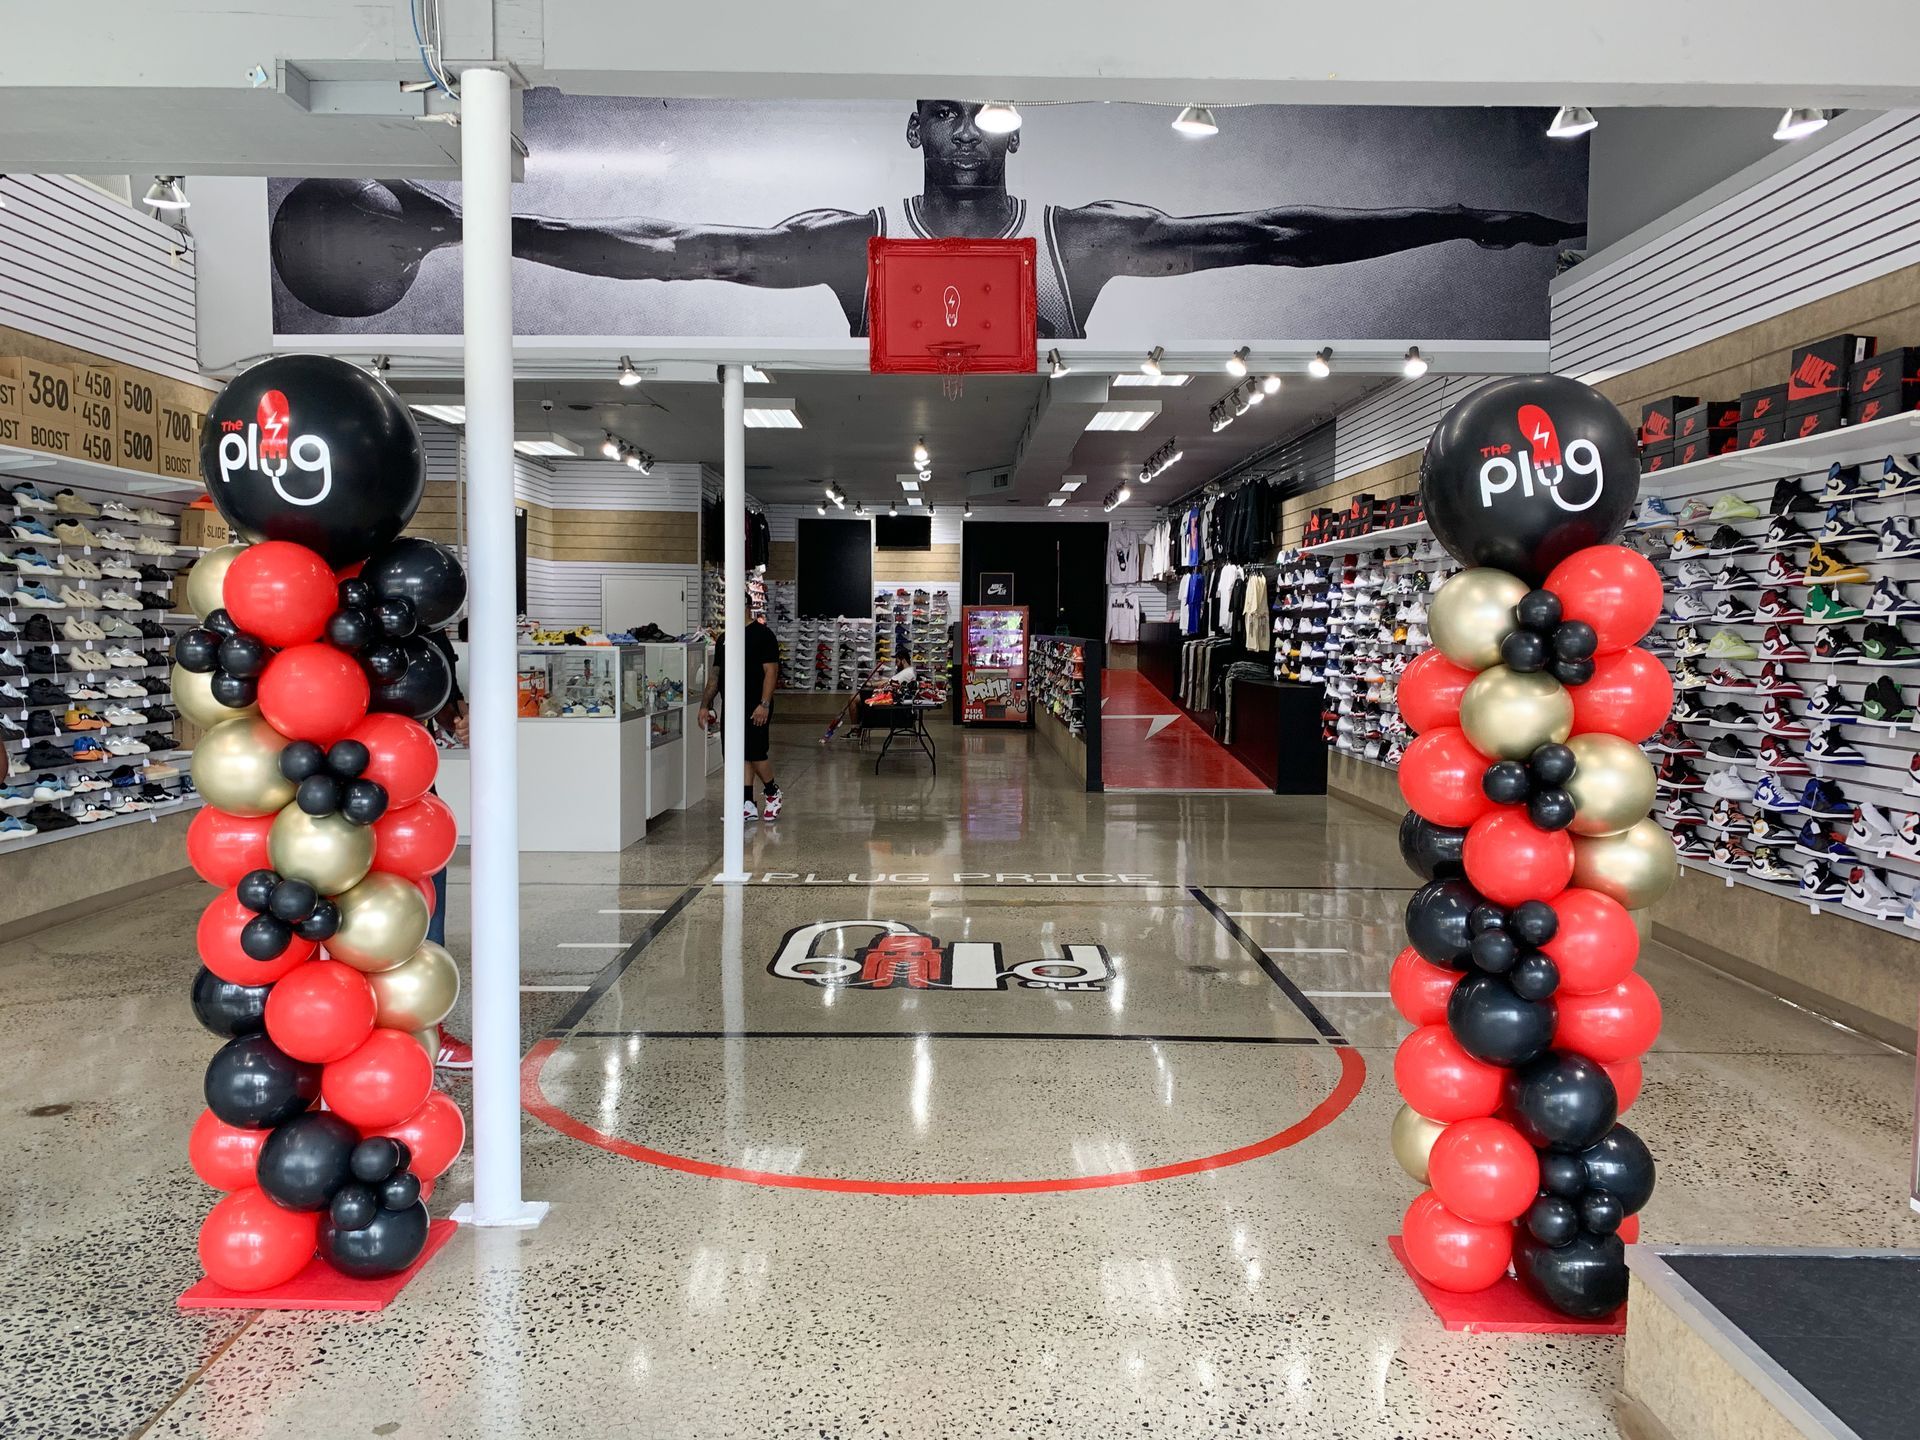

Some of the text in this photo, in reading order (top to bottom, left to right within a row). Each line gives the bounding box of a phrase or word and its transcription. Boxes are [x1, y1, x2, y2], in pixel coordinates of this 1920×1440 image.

[85, 370, 111, 399] 450
[1796, 354, 1838, 387] NIKE
[29, 370, 69, 411] 380
[124, 380, 153, 414] 500
[82, 401, 111, 431] 450
[162, 408, 191, 443] 700
[221, 420, 244, 432] The
[1647, 410, 1671, 434] NIKE
[31, 425, 70, 451] BOOST
[83, 433, 111, 462] 450
[124, 430, 153, 462] 500
[1480, 443, 1512, 458] The
[165, 455, 191, 474] BOOST
[219, 423, 332, 506] plug
[1480, 439, 1603, 512] plug
[206, 525, 226, 539] SLIDE
[761, 872, 1159, 885] PLUG PRICE
